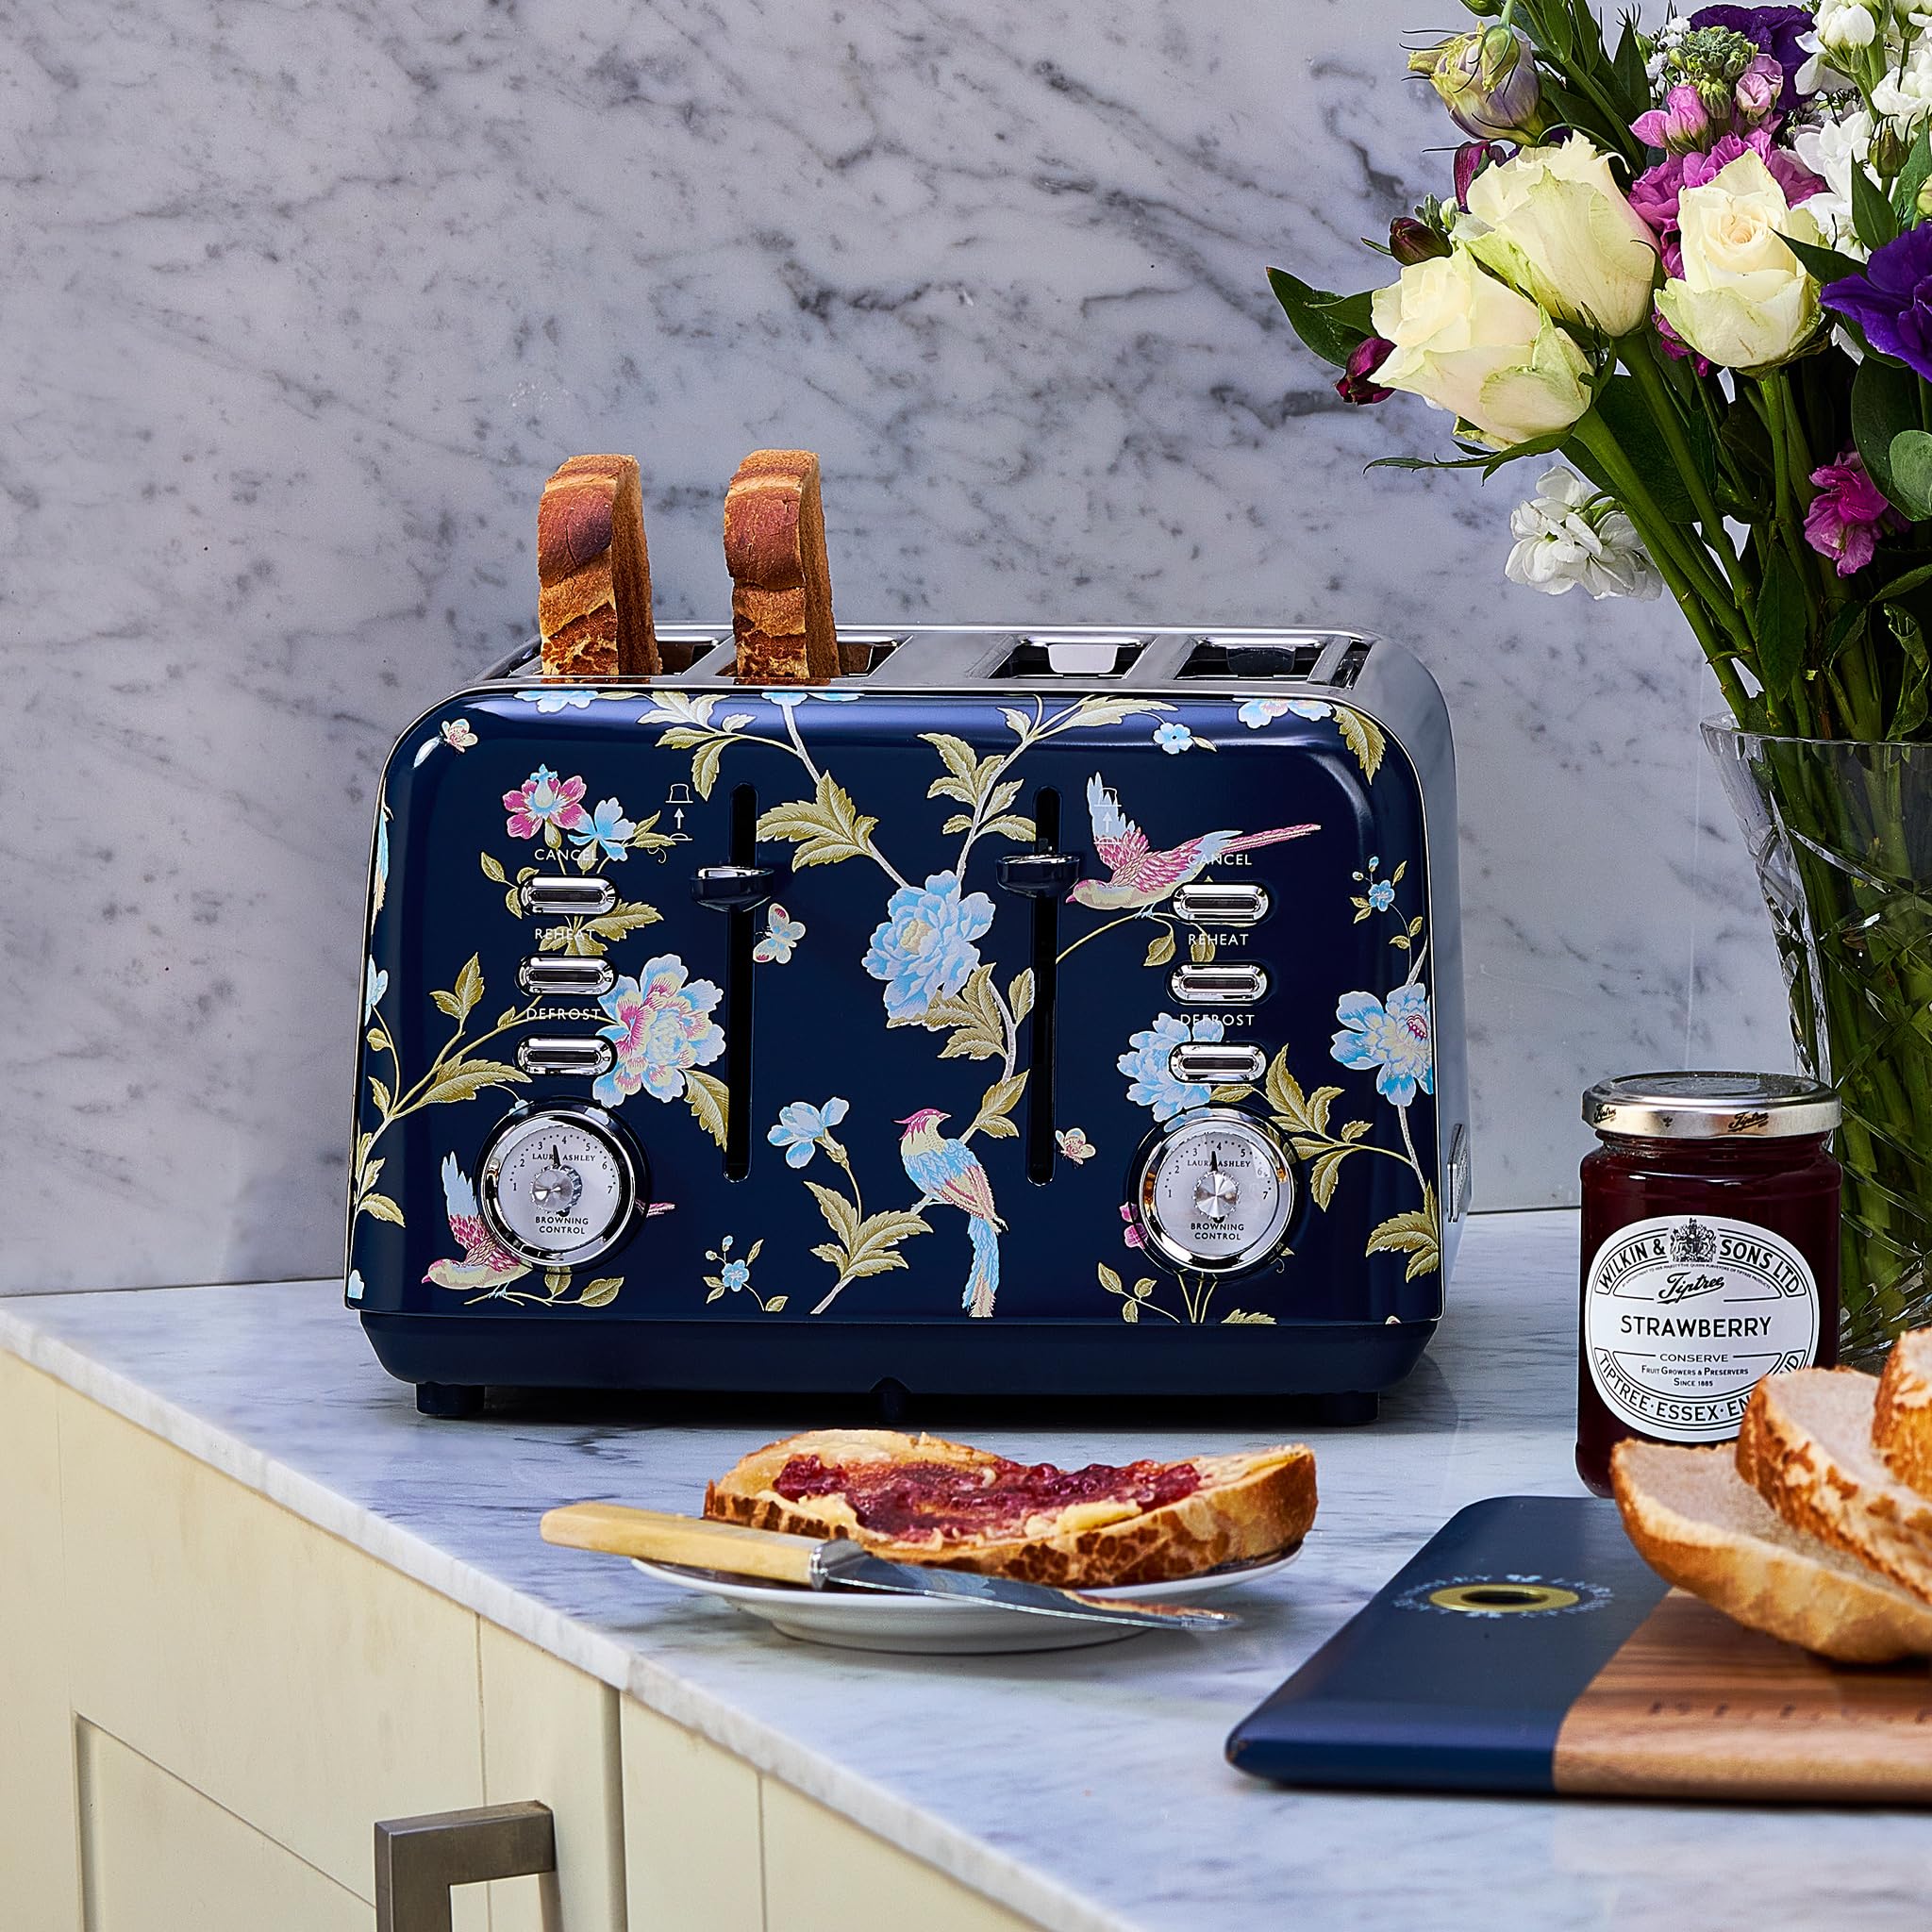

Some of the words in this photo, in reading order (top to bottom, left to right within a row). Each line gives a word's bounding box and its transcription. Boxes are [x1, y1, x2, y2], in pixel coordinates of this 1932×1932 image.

[534, 849, 599, 861] CANCEL
[1188, 854, 1253, 866] CANCEL
[534, 928, 594, 941] REHEAT
[1188, 934, 1249, 945] REHEAT
[526, 1008, 601, 1021] DEFROST
[1180, 1014, 1256, 1026] DEFROST
[512, 1182, 518, 1191] 1
[519, 1158, 525, 1168] 2
[538, 1141, 543, 1151] 3
[561, 1136, 567, 1145] 4
[585, 1142, 591, 1152] 5
[601, 1160, 608, 1170] 6
[608, 1185, 613, 1194] 7
[1168, 1190, 1173, 1198] 1
[1174, 1165, 1180, 1174] 2
[1192, 1147, 1198, 1157] 3
[1216, 1141, 1222, 1151] 4
[1240, 1148, 1246, 1158] 5
[1262, 1191, 1269, 1200] 7
[535, 1216, 589, 1225] BROWNING
[539, 1225, 586, 1235] CONTROL
[1191, 1223, 1244, 1231] BROWNING
[1194, 1232, 1241, 1241] CONTROL
[1599, 1243, 1648, 1289] WILKIN
[1653, 1239, 1666, 1256] &
[1720, 1239, 1774, 1270] SONS
[1774, 1262, 1800, 1292] LTD
[1657, 1272, 1725, 1304] Tiptree
[1621, 1315, 1773, 1338] STRAWBERRY
[1659, 1353, 1729, 1363] CONSERVE
[1641, 1364, 1659, 1374] FRUIT
[1660, 1366, 1696, 1375] GROWERS
[1704, 1367, 1749, 1376] PRESERVERS
[1674, 1377, 1696, 1387] SINCE
